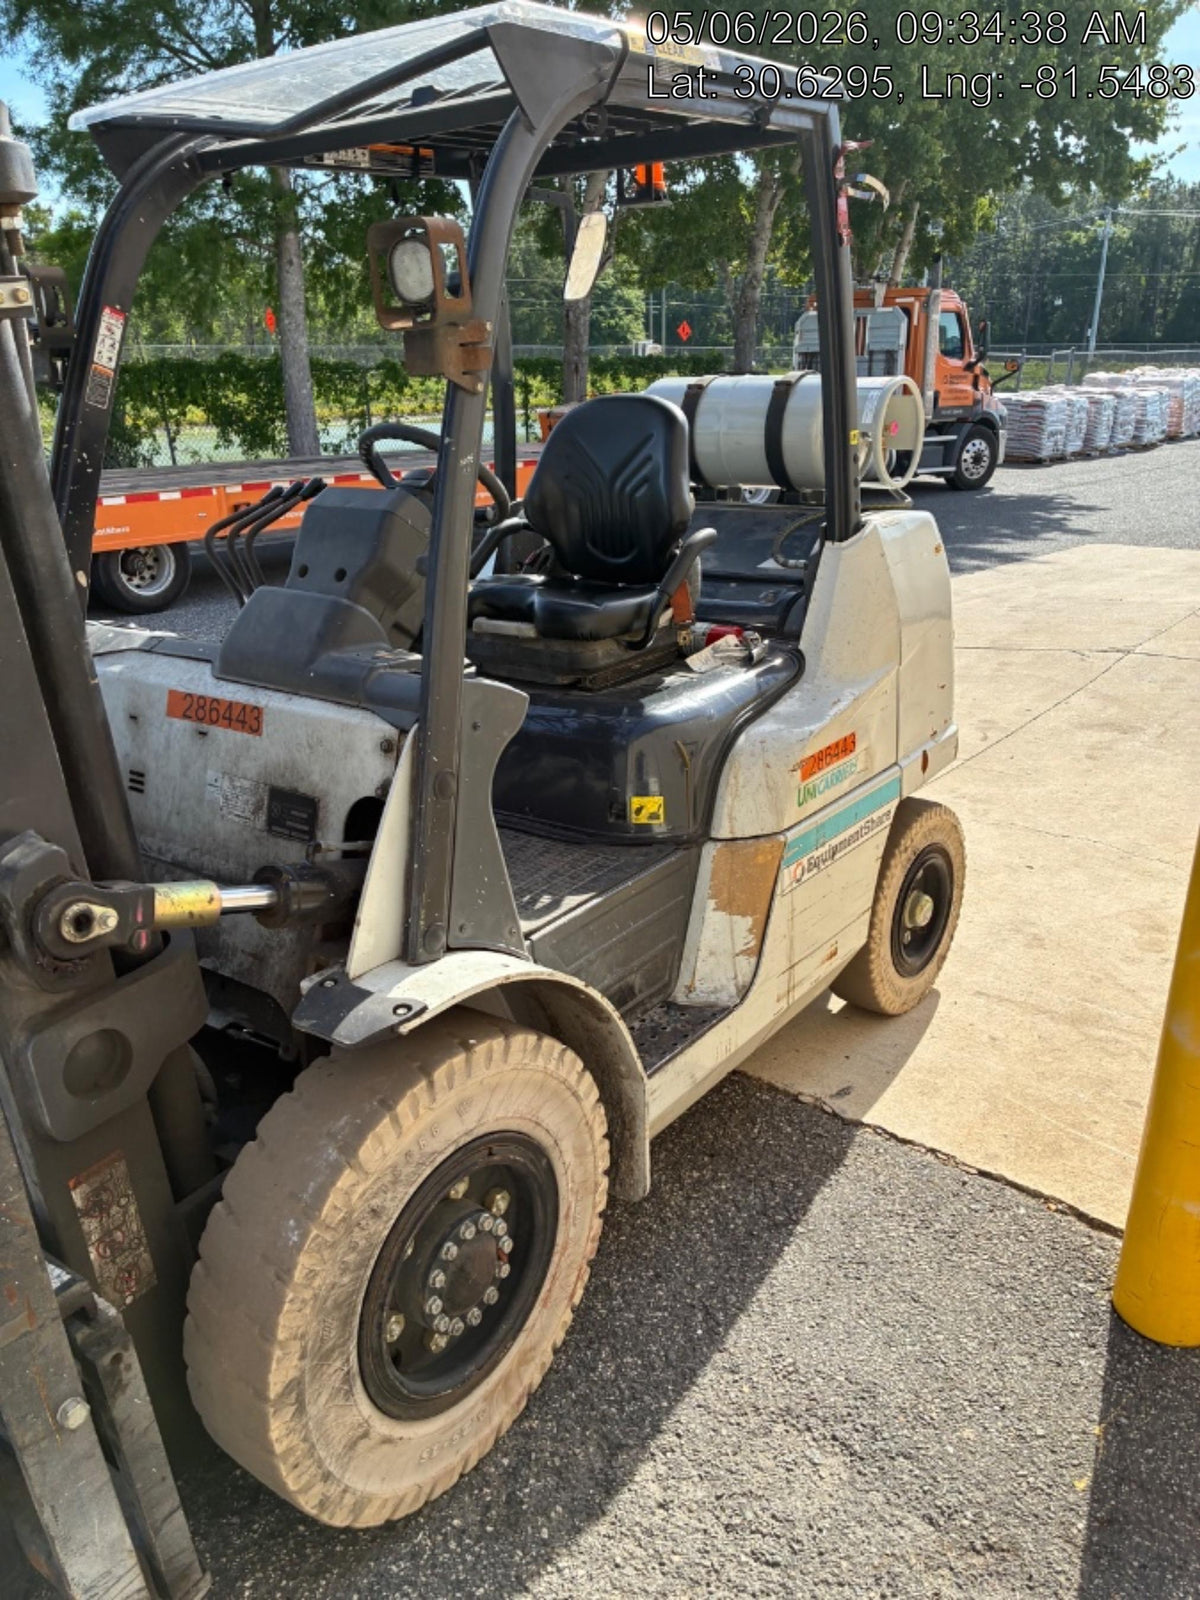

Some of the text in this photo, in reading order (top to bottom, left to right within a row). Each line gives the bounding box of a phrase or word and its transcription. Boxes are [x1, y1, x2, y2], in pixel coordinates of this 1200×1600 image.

[182, 692, 262, 734] 286443
[808, 731, 857, 777] 286443
[806, 808, 892, 874] EquipmentShare
